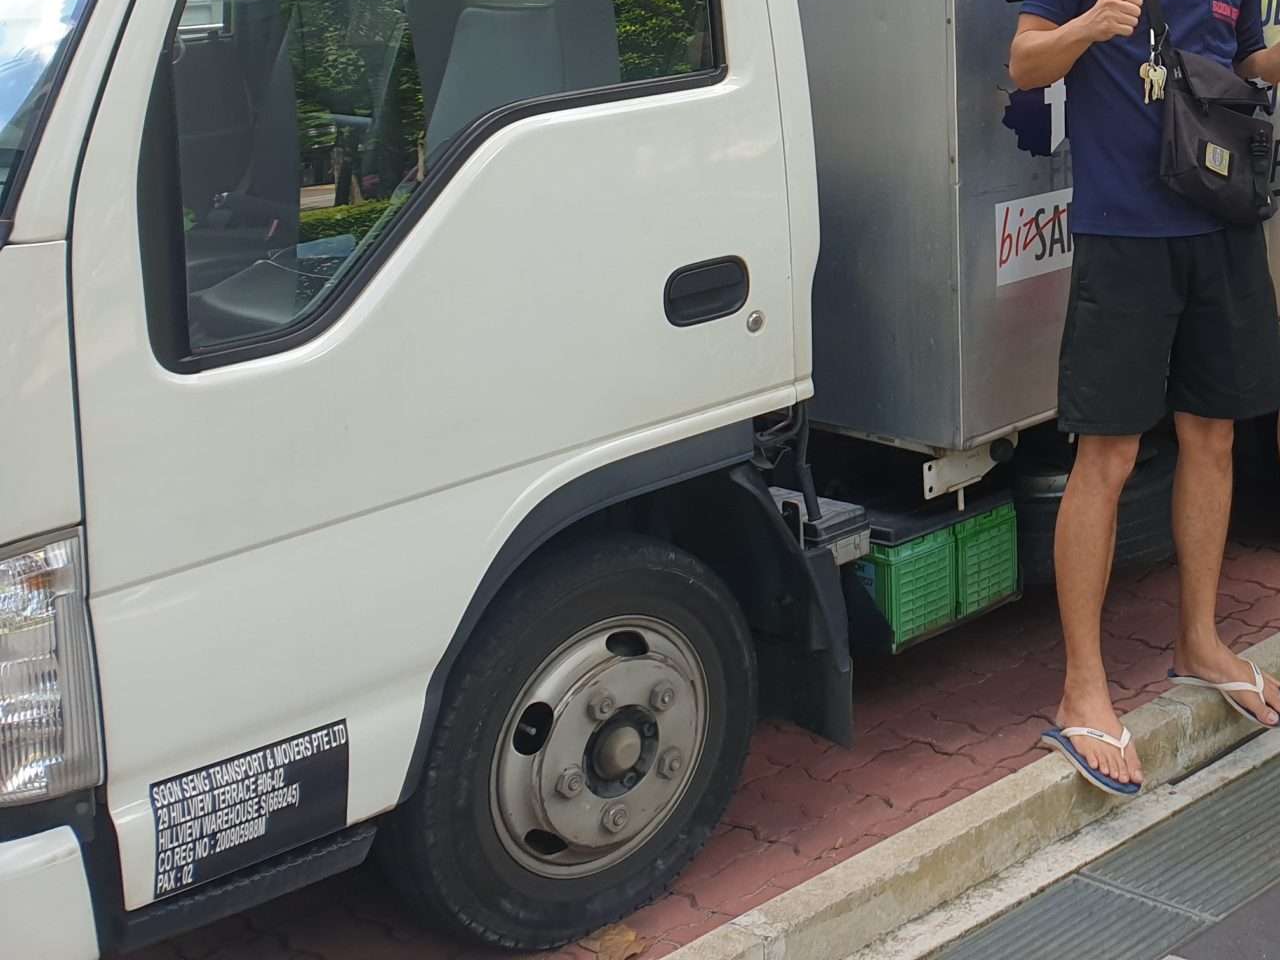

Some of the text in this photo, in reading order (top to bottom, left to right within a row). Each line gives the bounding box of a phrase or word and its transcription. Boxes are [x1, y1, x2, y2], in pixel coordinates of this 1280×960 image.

[152, 724, 347, 808] SOON SENG TRANSPORT & MOVERS PTE LTD
[157, 767, 285, 830] 29 HILLVIEW TERRACE #06-02
[158, 782, 300, 851] HILLVIEW WAREHOUSE S(669245)
[156, 869, 176, 894] PAX
[182, 863, 193, 885] 02
[158, 850, 172, 873] CO
[173, 843, 194, 868] REG
[194, 837, 210, 860] NO
